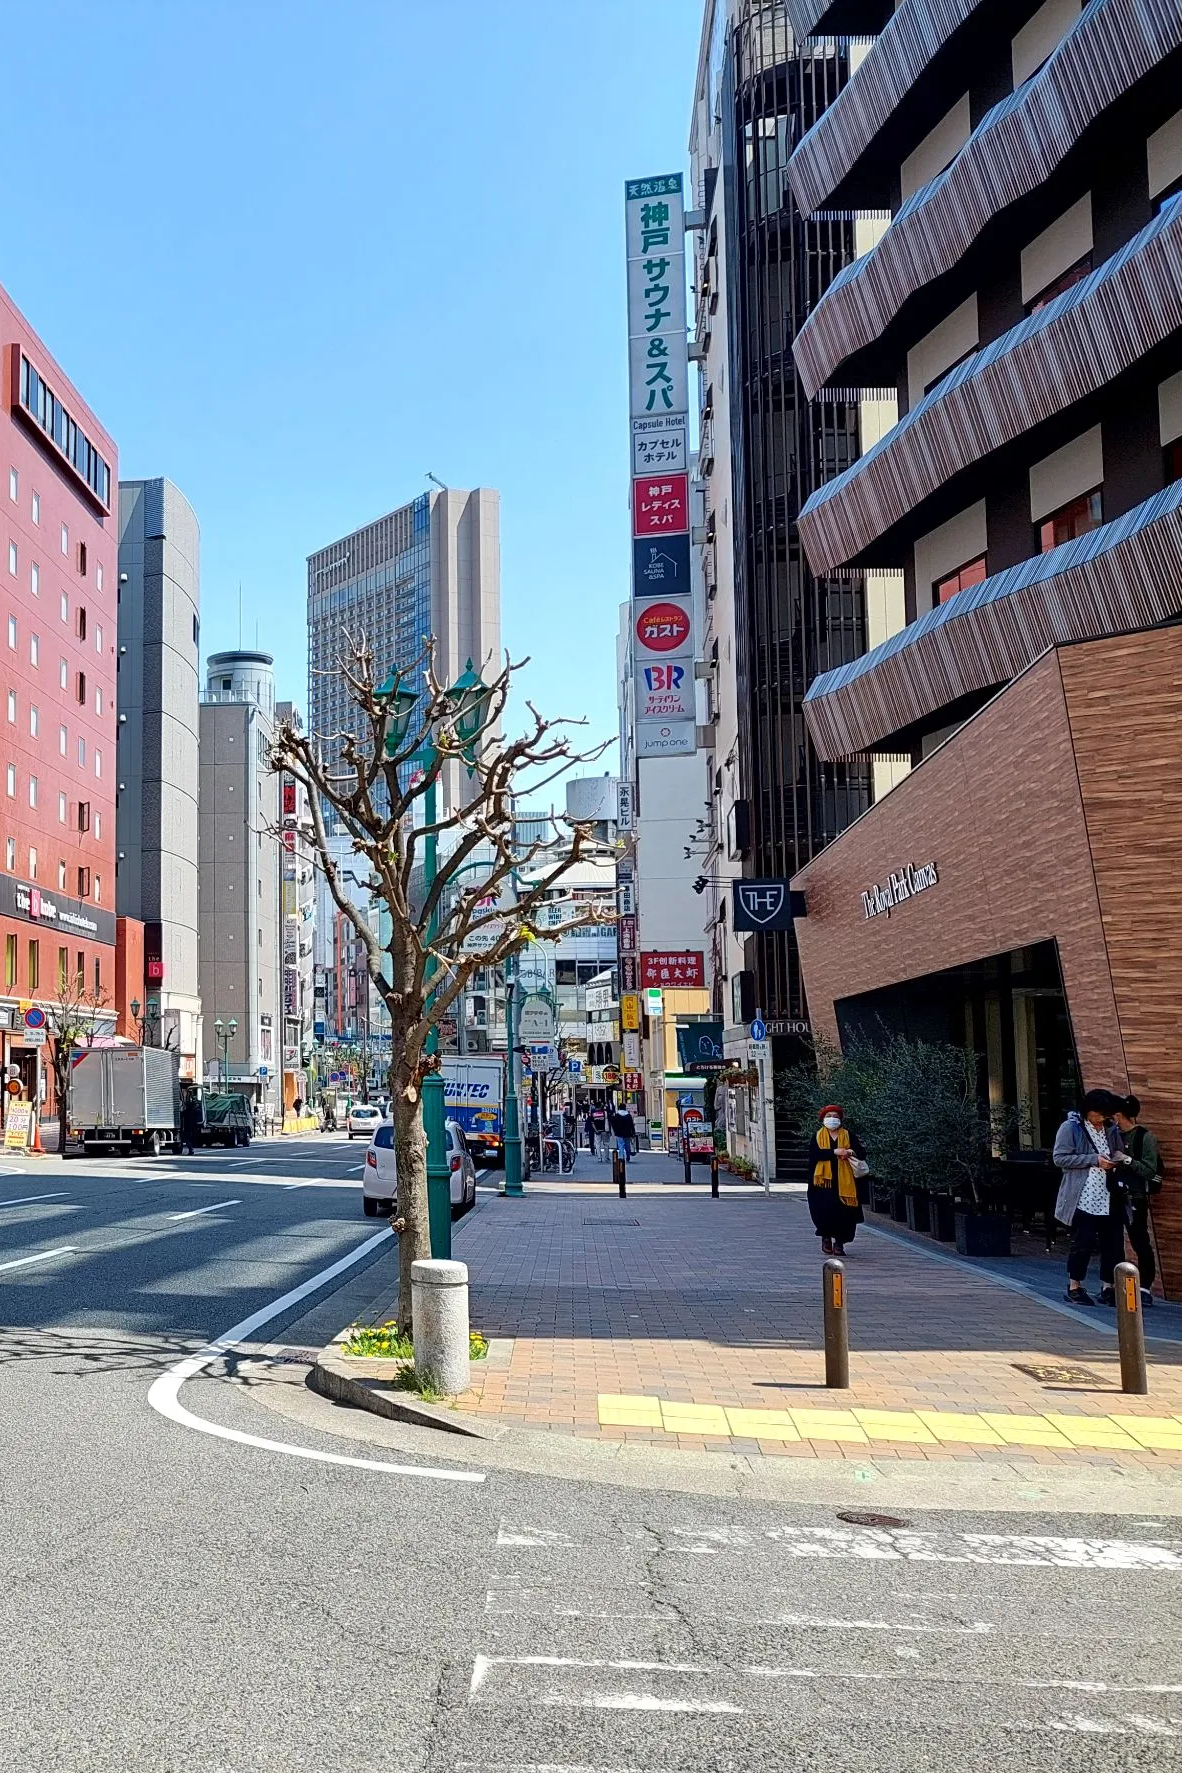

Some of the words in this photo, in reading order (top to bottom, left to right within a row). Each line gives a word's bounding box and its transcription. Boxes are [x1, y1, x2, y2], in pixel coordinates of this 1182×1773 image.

[628, 177, 680, 197] 天然温泉
[633, 418, 664, 431] Capsule
[665, 415, 686, 427] Hotel
[637, 438, 682, 452] カプセル
[644, 451, 678, 463] ホテル
[648, 485, 672, 497] 神戸
[650, 514, 673, 525] スパ
[644, 624, 685, 638] ガスト
[644, 704, 685, 714] アイスクリーム
[644, 740, 669, 749] jump
[669, 738, 688, 746] one
[907, 862, 938, 895] Canvas
[17, 892, 31, 911] the
[745, 891, 778, 911] THE
[787, 1021, 811, 1033] HOU
[571, 1063, 579, 1072] P
[444, 1083, 489, 1098] UNTEC
